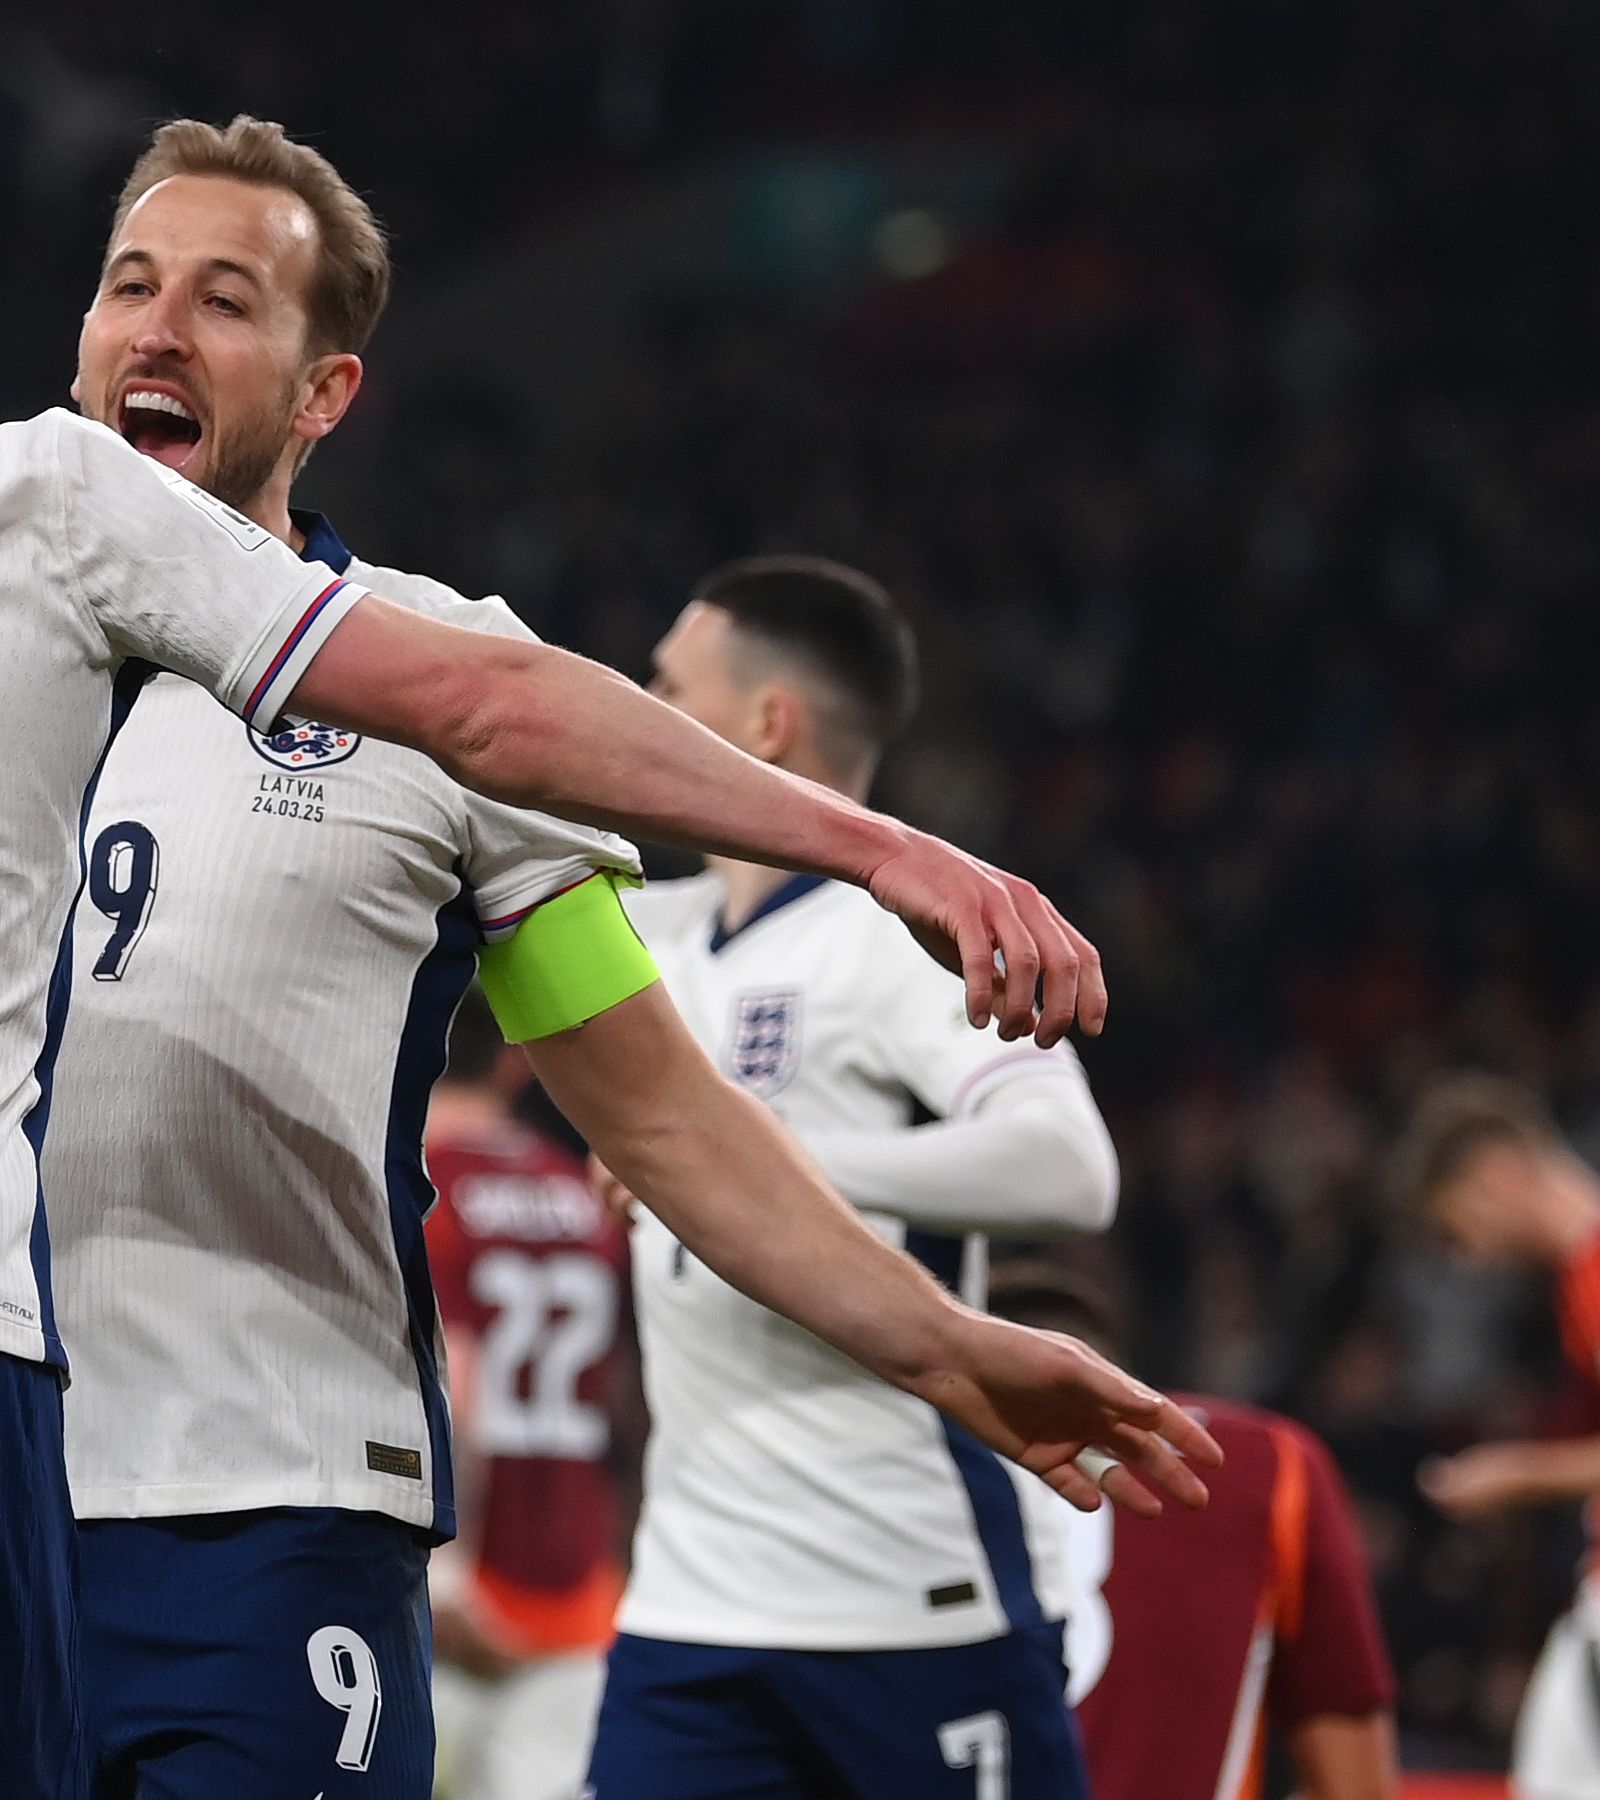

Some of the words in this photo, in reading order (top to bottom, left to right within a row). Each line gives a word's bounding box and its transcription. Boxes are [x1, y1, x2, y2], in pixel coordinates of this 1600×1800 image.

[251, 796, 325, 823] 24.03.25
[260, 773, 324, 801] LATVIA
[89, 820, 160, 982] 9
[469, 1250, 619, 1460] 22
[306, 1625, 382, 1772] 9
[935, 1708, 1011, 1800] 7
